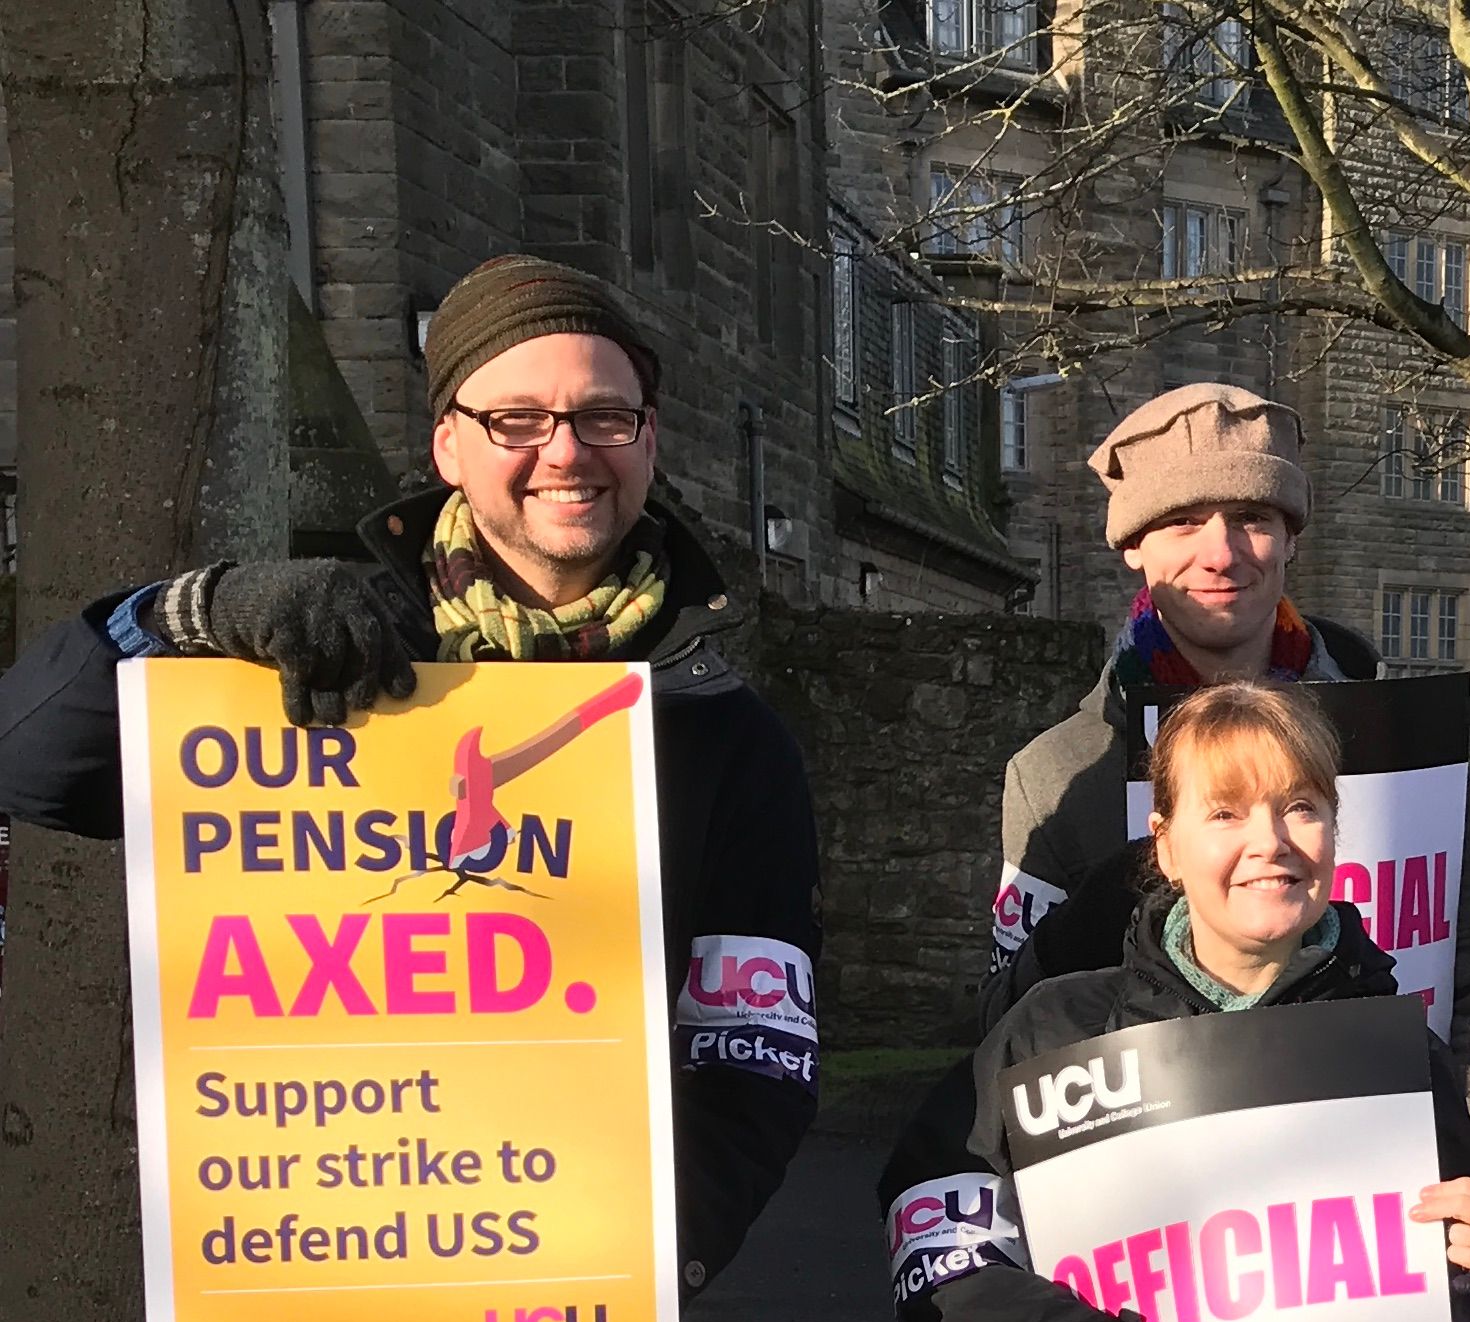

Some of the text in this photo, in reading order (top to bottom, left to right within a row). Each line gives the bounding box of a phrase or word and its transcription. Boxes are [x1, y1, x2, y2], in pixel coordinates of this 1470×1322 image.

[180, 726, 359, 788] OUR
[182, 811, 573, 879] PENSION
[187, 911, 597, 1019] AXED.
[691, 1030, 815, 1082] Picket
[196, 1070, 440, 1127] Support
[199, 1138, 557, 1190] our strike to
[202, 1210, 540, 1264] defend USS
